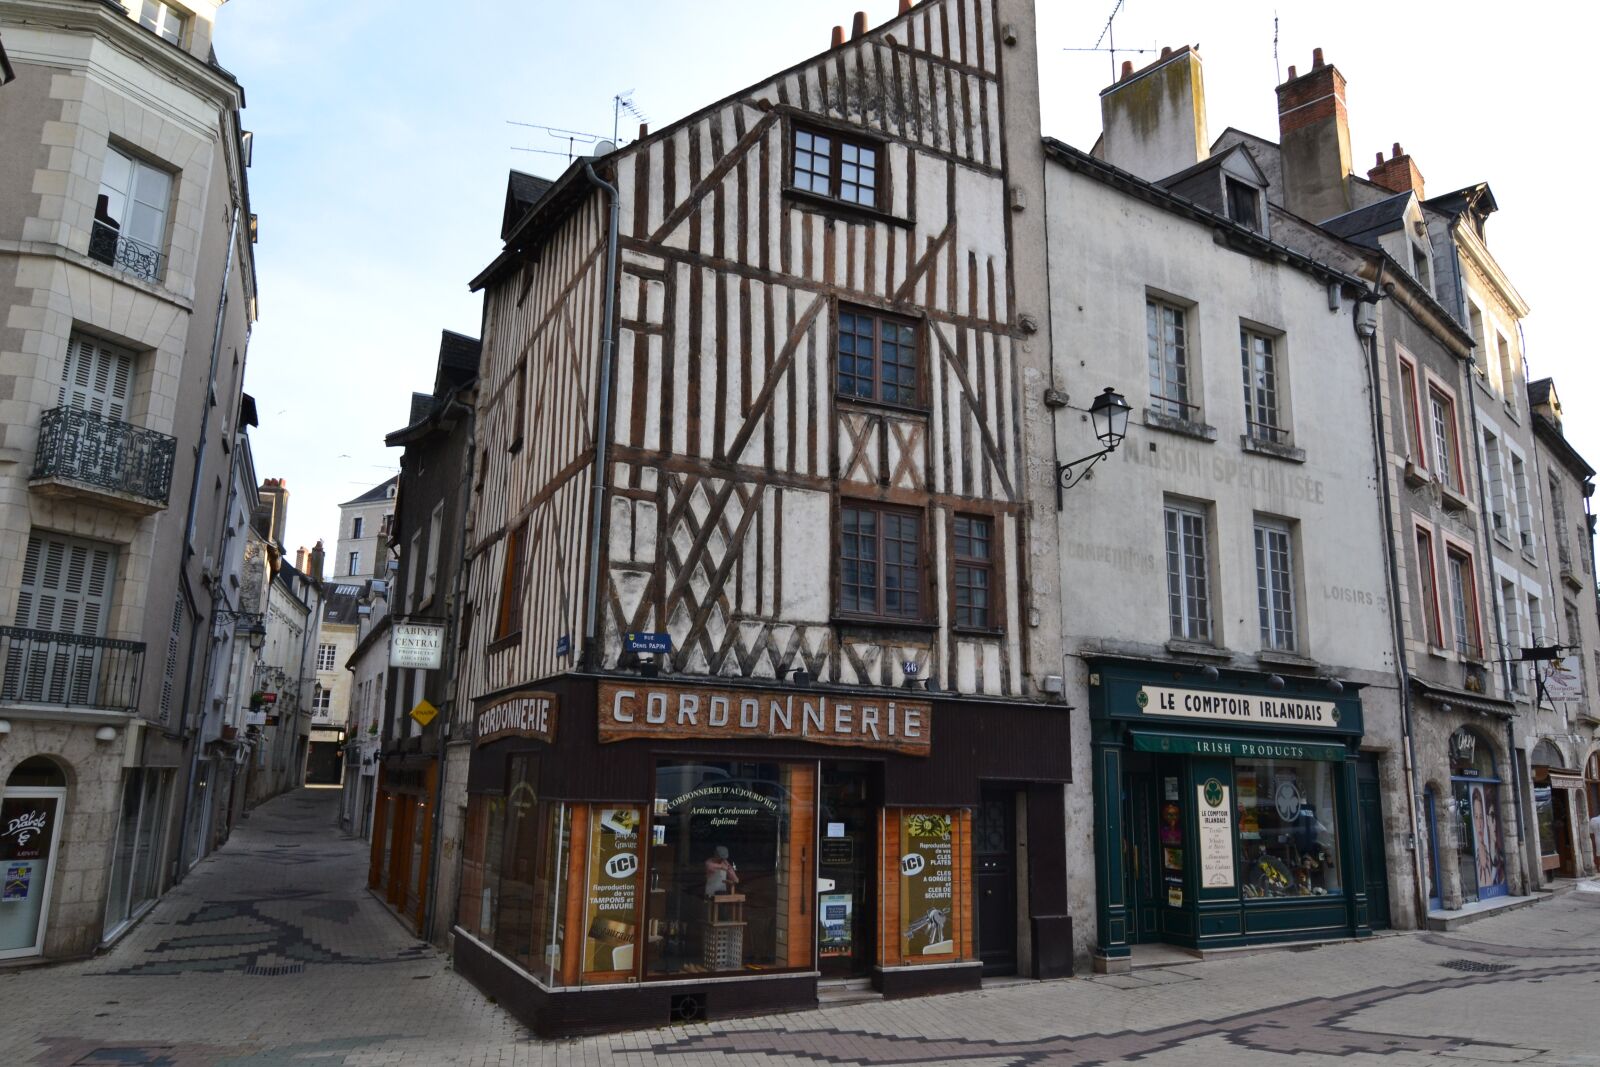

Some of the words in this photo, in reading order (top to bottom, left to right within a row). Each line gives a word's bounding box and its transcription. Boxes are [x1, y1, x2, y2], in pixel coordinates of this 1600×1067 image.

[1323, 585, 1373, 605] LOISIRS
[397, 626, 440, 637] CABINET
[395, 638, 440, 648] CENTRAL
[904, 662, 917, 673] 46
[1160, 692, 1175, 710] LE
[1184, 694, 1250, 716] COMPTOIR
[1260, 700, 1322, 721] IRLANDAIS
[478, 698, 550, 736] CORDONNERIE
[613, 690, 921, 741] CORDONNERIE
[1197, 741, 1232, 753] IRISH
[1242, 744, 1303, 757] PRODUCTS
[667, 786, 721, 810] CORDONNERIE
[691, 807, 717, 815] Artisan
[718, 807, 759, 815] Cordonnier
[615, 840, 637, 849] Gravure
[592, 884, 635, 892] Reproduction
